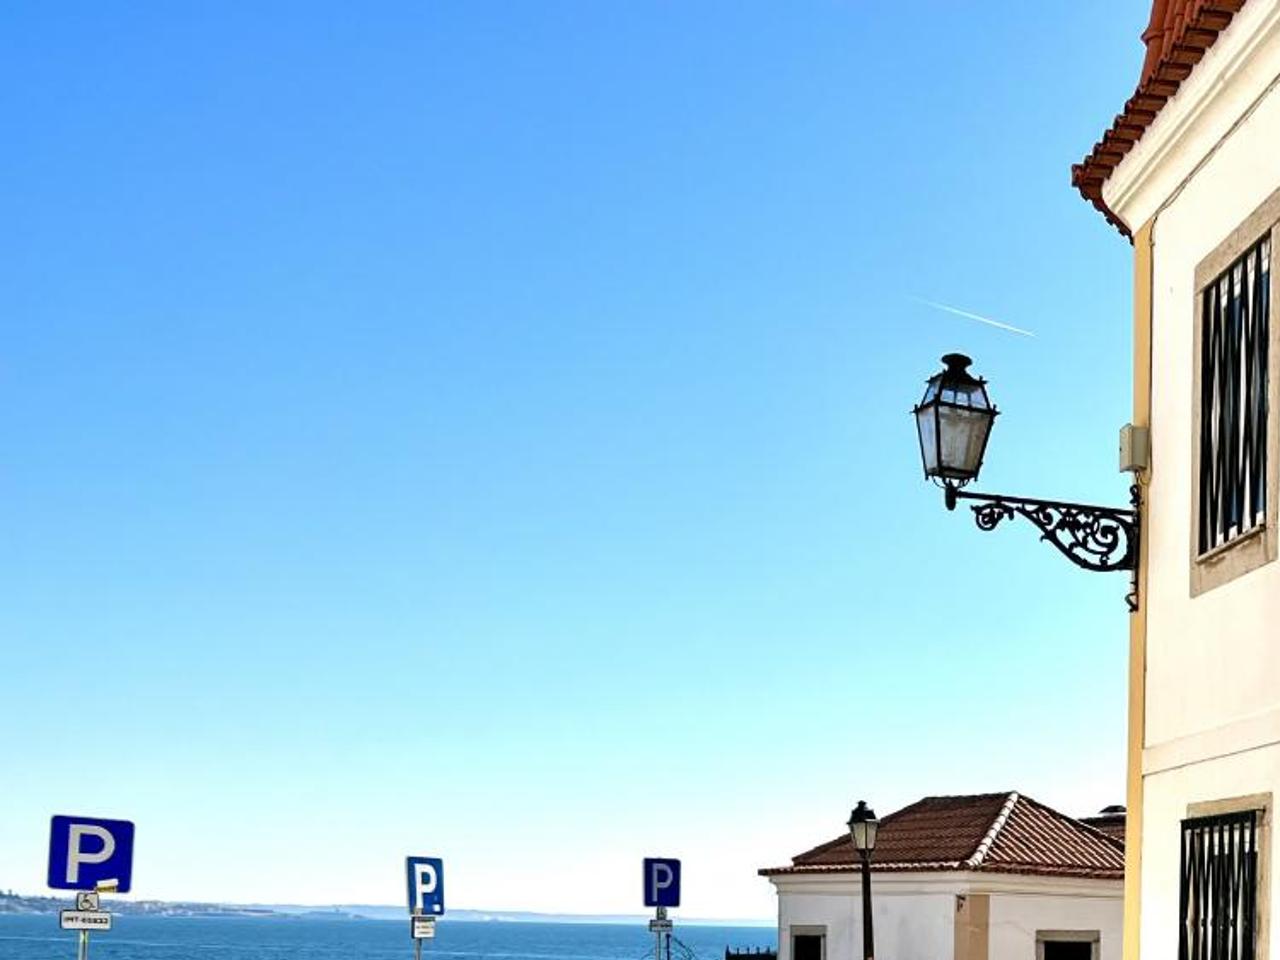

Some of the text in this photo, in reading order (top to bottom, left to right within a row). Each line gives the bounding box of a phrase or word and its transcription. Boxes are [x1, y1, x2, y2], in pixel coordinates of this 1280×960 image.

[65, 823, 116, 884] P
[414, 862, 438, 909] P
[650, 862, 674, 903] P
